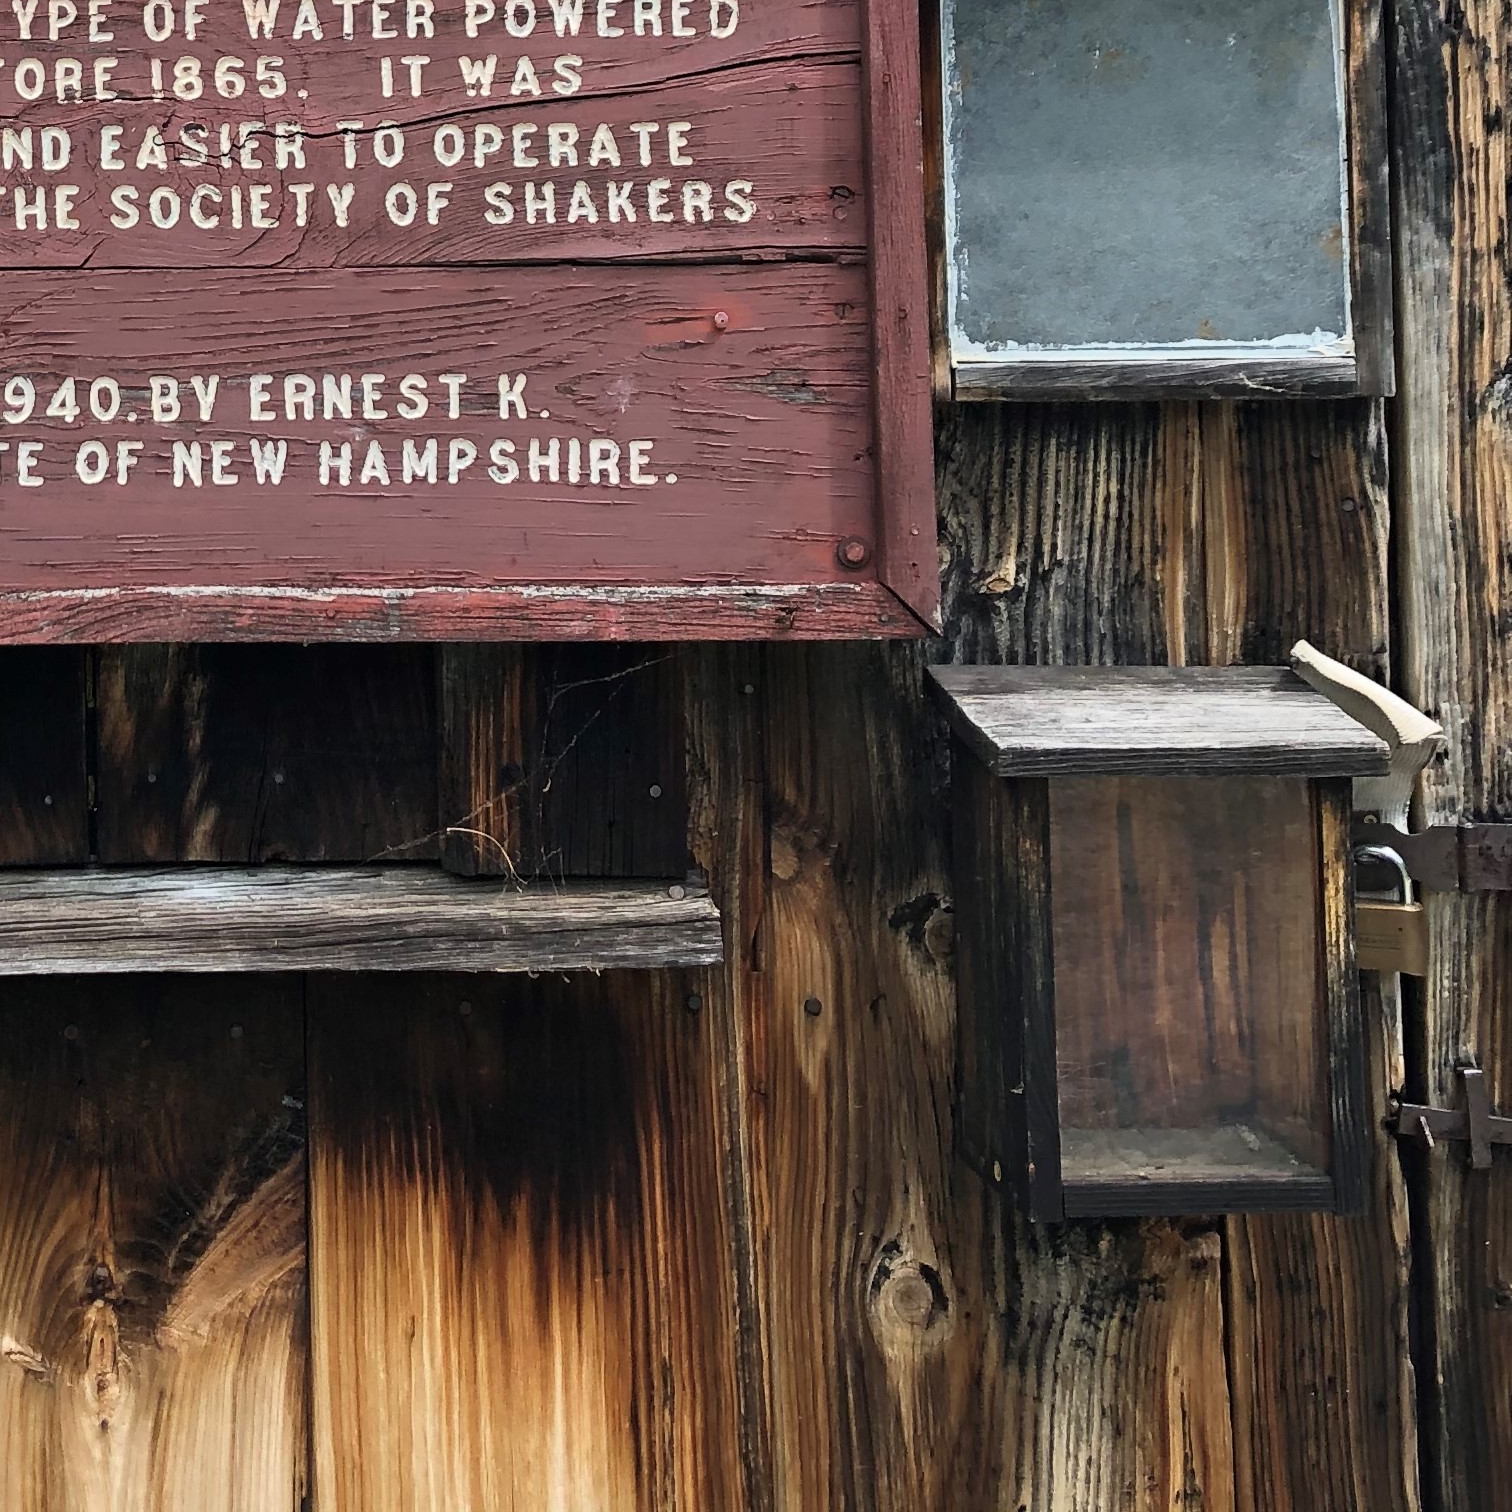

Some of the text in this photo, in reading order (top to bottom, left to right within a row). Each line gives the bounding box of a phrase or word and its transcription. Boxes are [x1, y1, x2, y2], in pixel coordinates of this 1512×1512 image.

[151, 56, 308, 102] 1865.
[381, 55, 430, 98] IT
[458, 54, 586, 102] WAS
[101, 121, 307, 170] EASIER
[336, 120, 404, 169] TO
[434, 121, 693, 168] OPERATE
[110, 183, 355, 229] SOCIETY
[385, 183, 452, 226] OF
[484, 178, 756, 225] SHAKERS
[250, 374, 473, 421] ERNEST
[498, 374, 549, 419] K.
[75, 441, 144, 485] OF
[169, 433, 287, 487] NEW
[319, 438, 677, 486] HAMPSHIRE.
